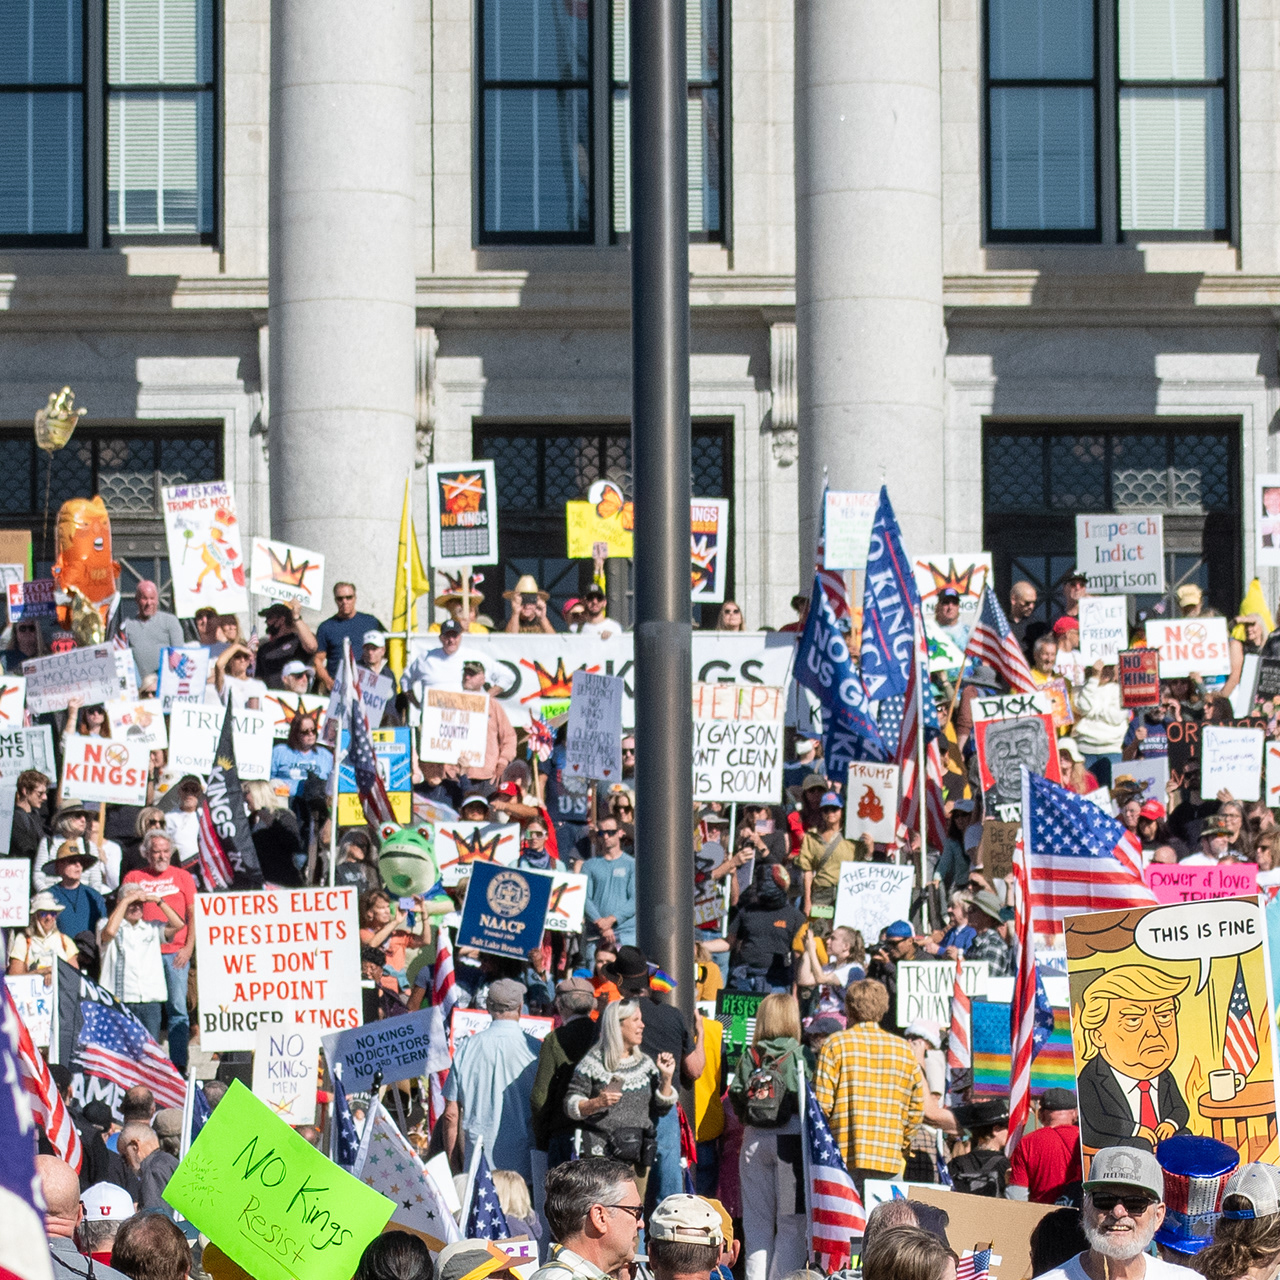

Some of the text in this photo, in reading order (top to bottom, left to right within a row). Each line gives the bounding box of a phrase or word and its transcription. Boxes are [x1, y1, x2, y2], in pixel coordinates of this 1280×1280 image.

[167, 484, 228, 500] LAW IS KING
[167, 496, 232, 512] TRUMP IS NOT
[441, 510, 488, 527] NO KINGS
[1084, 517, 1158, 541] Impeach
[1095, 544, 1144, 563] Indict
[261, 585, 312, 606] NO KINGS
[1082, 626, 1123, 641] FREEDOM
[1090, 644, 1119, 658] RING
[1124, 656, 1141, 670] NO
[1124, 671, 1156, 686] KING
[980, 696, 1043, 718] DICK
[439, 724, 469, 740] COUNTRY
[708, 724, 778, 745] GAY SON
[726, 749, 777, 768] CLEAN
[66, 761, 147, 788] KINGS!
[721, 771, 771, 794] ROOM
[852, 765, 894, 780] TRUMP
[841, 866, 911, 885] THE PHONY
[1150, 870, 1250, 892] power love
[848, 879, 901, 896] KING OF
[200, 889, 353, 917] VOTERS ELECT
[208, 919, 347, 946] PRESIDENTS
[478, 914, 526, 934] NAACP
[1149, 919, 1257, 943] THIS IS FINE
[222, 947, 334, 975] WE DON'T
[232, 979, 328, 1003] APPOINT
[295, 1007, 359, 1029] KINGS
[269, 1033, 305, 1058] NO
[355, 1024, 415, 1048] NO KINGS
[345, 1034, 431, 1067] NO DICTATORS
[354, 1050, 430, 1080] NO TERM
[272, 1080, 298, 1095] MEN
[232, 1135, 354, 1251] NO Kings
[100, 1206, 111, 1216] U
[237, 1193, 306, 1264] Resist
